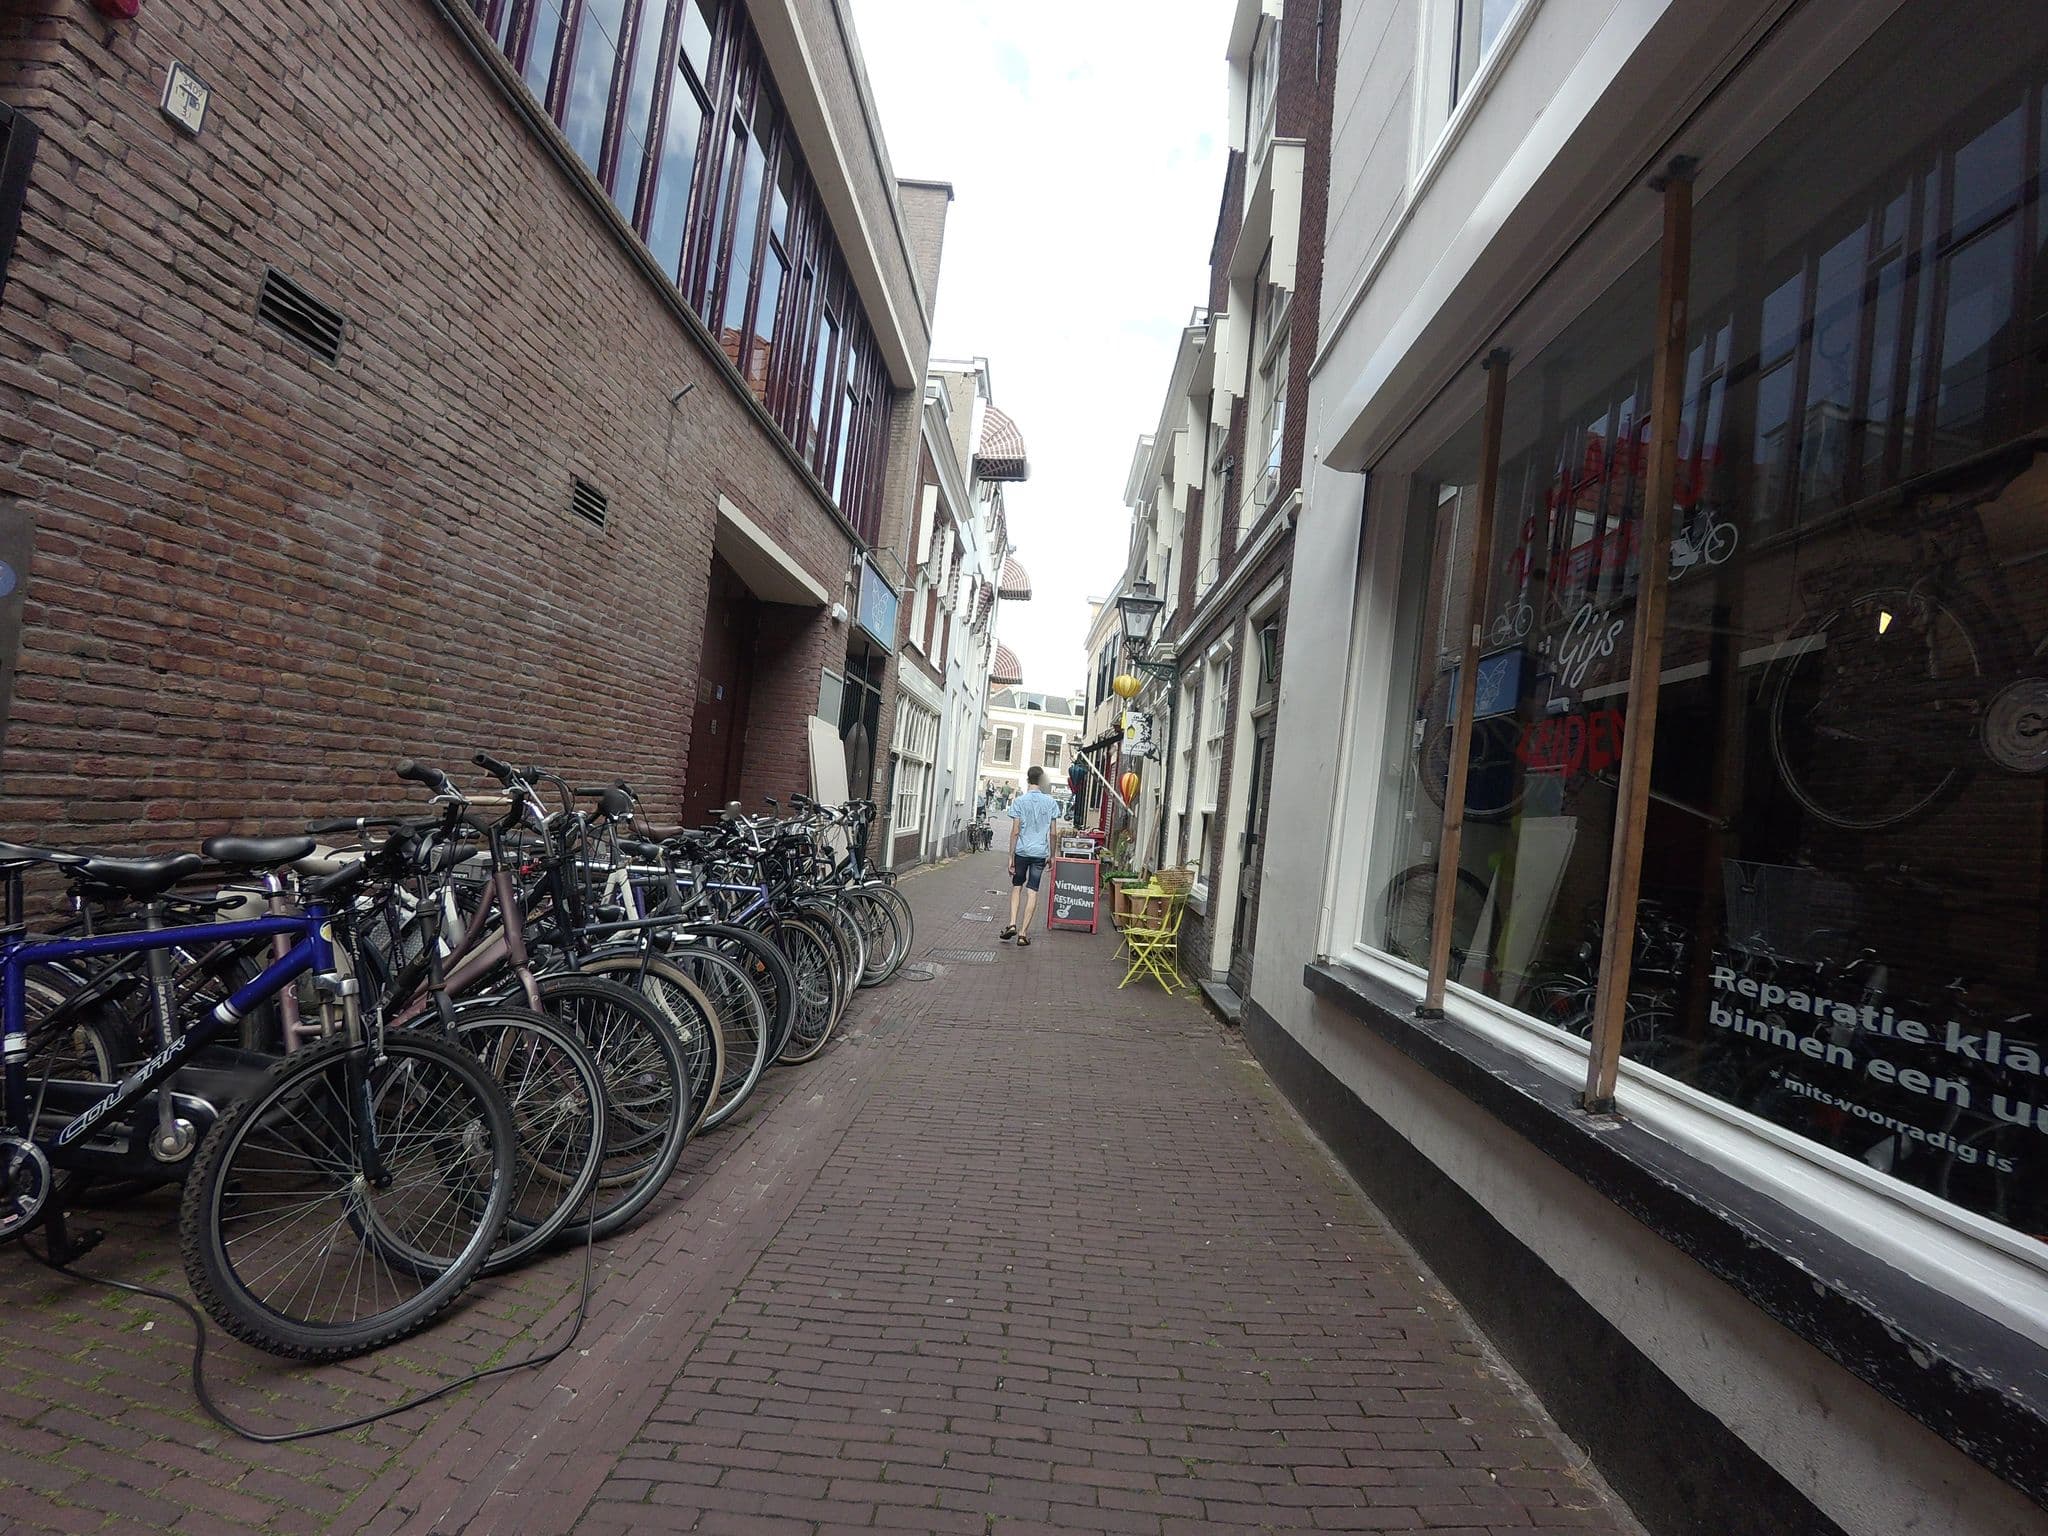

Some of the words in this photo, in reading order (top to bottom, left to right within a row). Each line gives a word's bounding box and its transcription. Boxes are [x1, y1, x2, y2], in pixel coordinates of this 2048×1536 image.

[1559, 603, 1624, 688] Gijs
[1709, 1001, 1854, 1070] binnen
[1868, 1059, 1971, 1108] een
[1713, 966, 1929, 1044] Reparatie
[1945, 1021, 2048, 1076] kla
[59, 1034, 186, 1145] COUAR
[1838, 1098, 1978, 1164] voorradig
[1987, 1150, 2014, 1173] is
